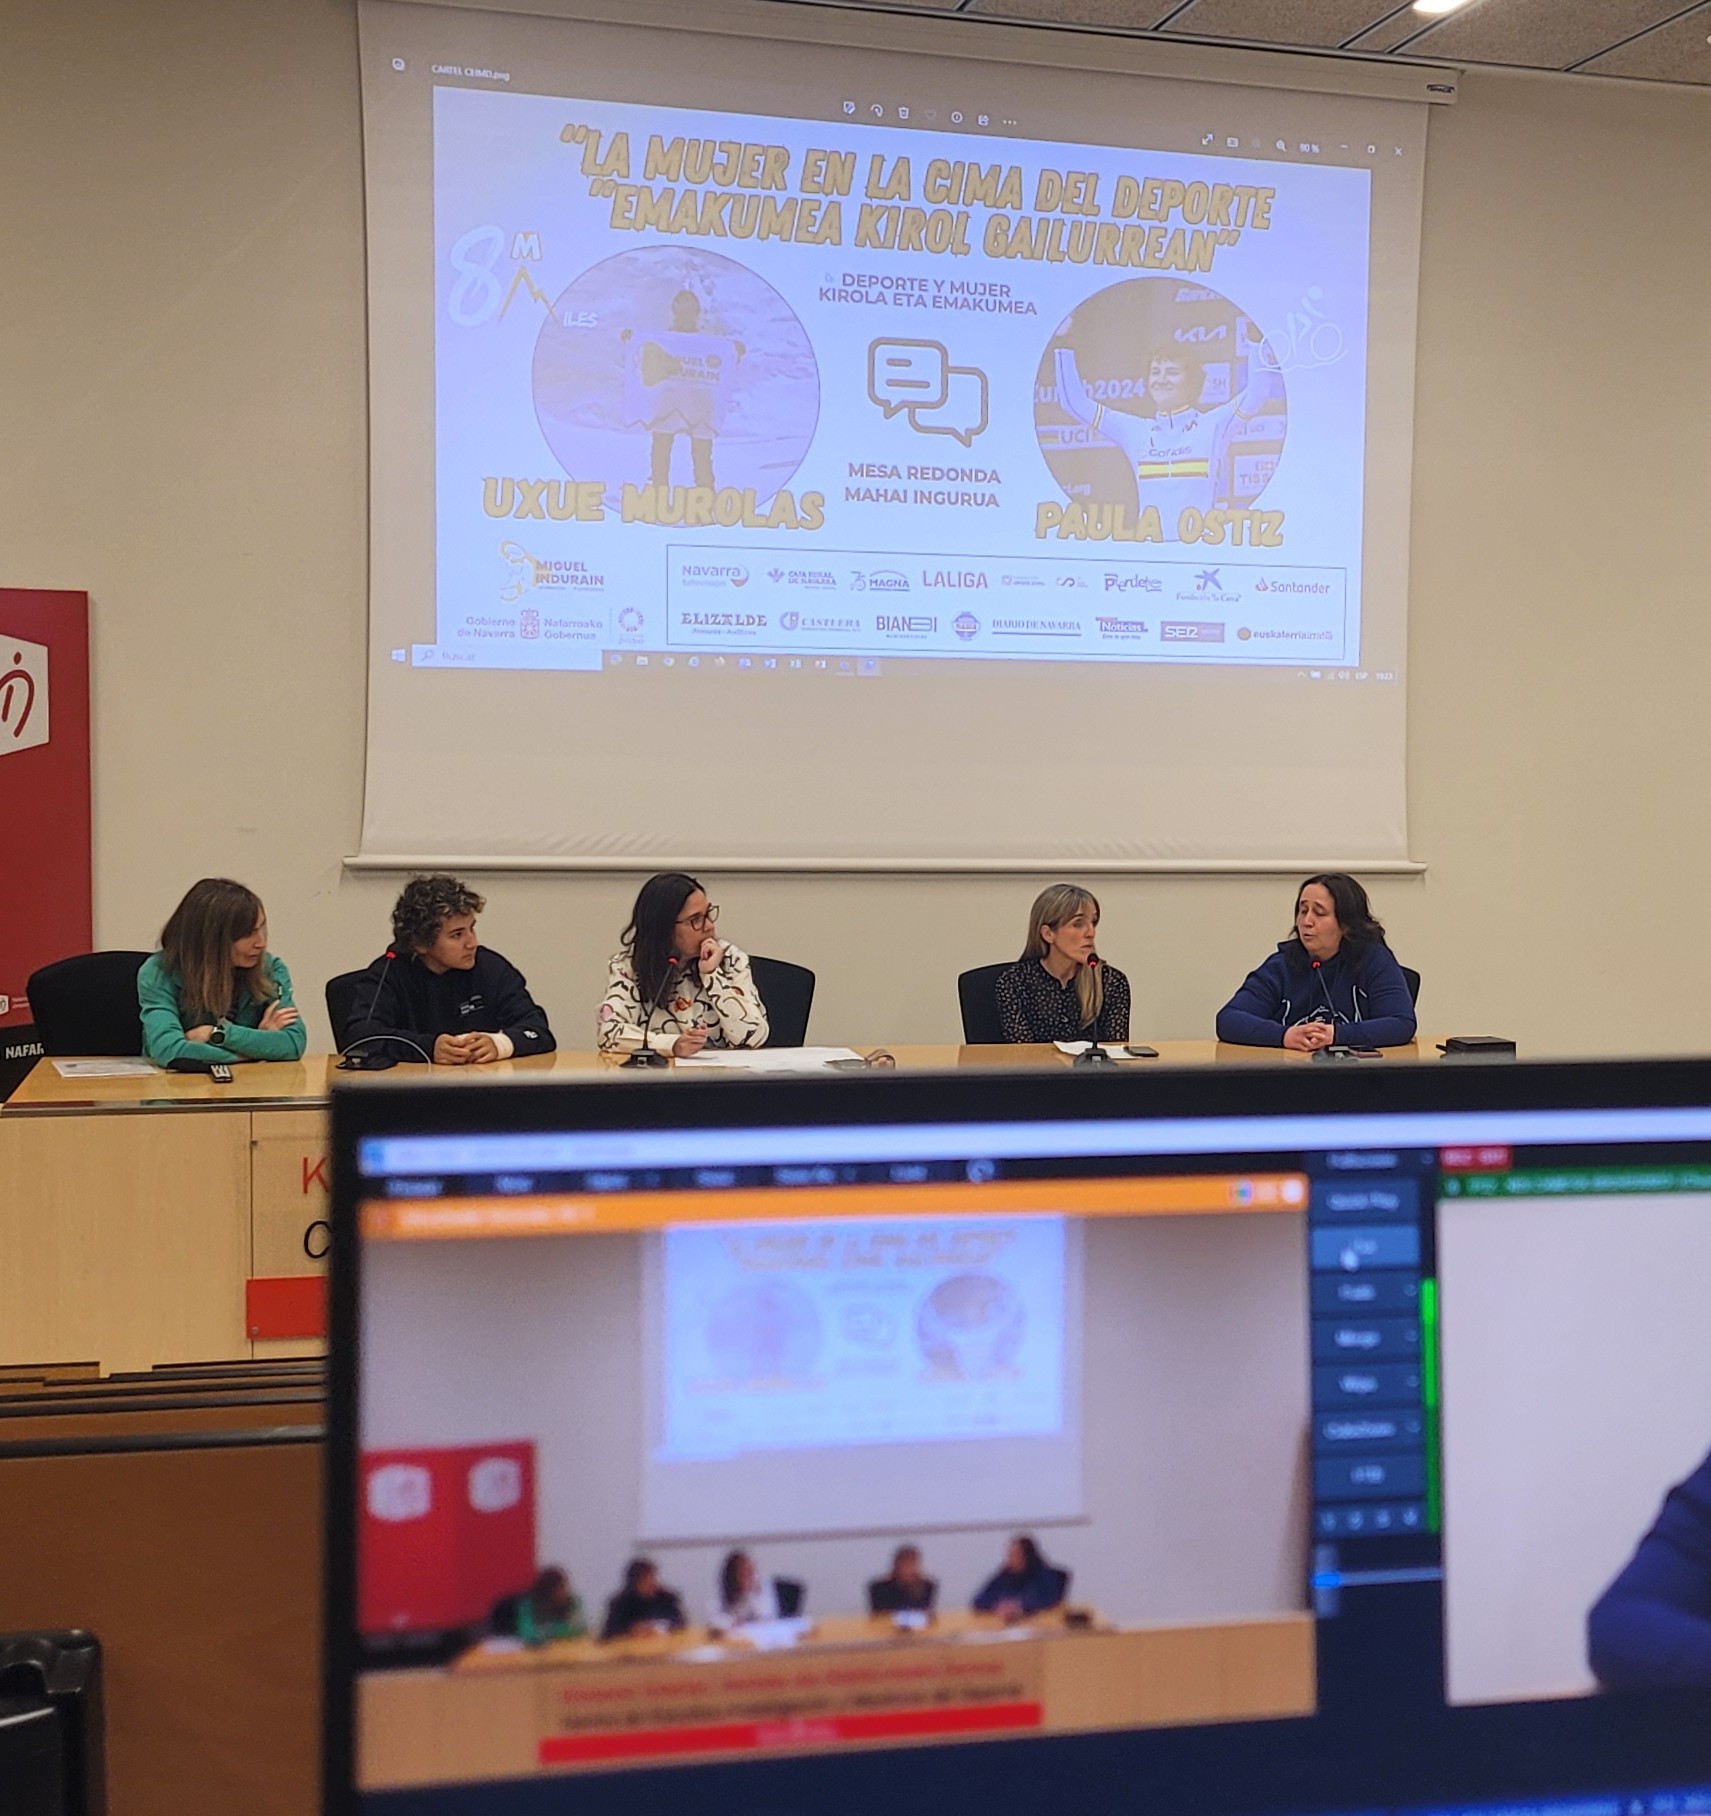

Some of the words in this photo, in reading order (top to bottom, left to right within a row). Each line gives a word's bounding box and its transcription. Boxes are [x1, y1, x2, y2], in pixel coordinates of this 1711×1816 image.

[645, 134, 791, 192] MUJER
[802, 148, 857, 201] EN
[865, 153, 912, 202] LA
[924, 160, 1022, 211] CIMA
[1034, 168, 1100, 217] DEL
[1111, 174, 1276, 231] DEPORTE
[854, 203, 971, 257] KIROL
[842, 272, 929, 293] DEPORTE
[933, 279, 945, 293] Y
[949, 280, 1011, 298] MUJER
[818, 287, 888, 307] KIROLA
[893, 291, 928, 308] ETA
[932, 294, 1038, 317] EMAKUMEA
[1060, 429, 1091, 445] UCI
[848, 462, 902, 480] MESA
[906, 465, 1002, 485] REDONDA
[483, 476, 605, 523] UXUE
[620, 481, 826, 531] MUROLAS
[844, 486, 908, 504] MAHAI
[913, 490, 1000, 508] INGURUA
[1034, 501, 1164, 543] PAULA
[1177, 506, 1285, 547] OSTIZ
[534, 560, 588, 573] MIGUEL
[681, 564, 742, 578] Navarra
[534, 572, 605, 587] INDURAIN
[868, 577, 910, 589] MAGNA
[921, 569, 988, 590] LALIGA
[1269, 580, 1331, 596] Santander
[466, 615, 516, 628] Gobierno
[543, 617, 603, 630] Nafarroako
[680, 612, 768, 627] ELIZALDE
[992, 619, 1025, 630] DIARIO
[1038, 620, 1082, 631] NAVARRA
[456, 628, 473, 638] de
[473, 628, 515, 640] Navarra
[543, 629, 597, 641] Gobernua
